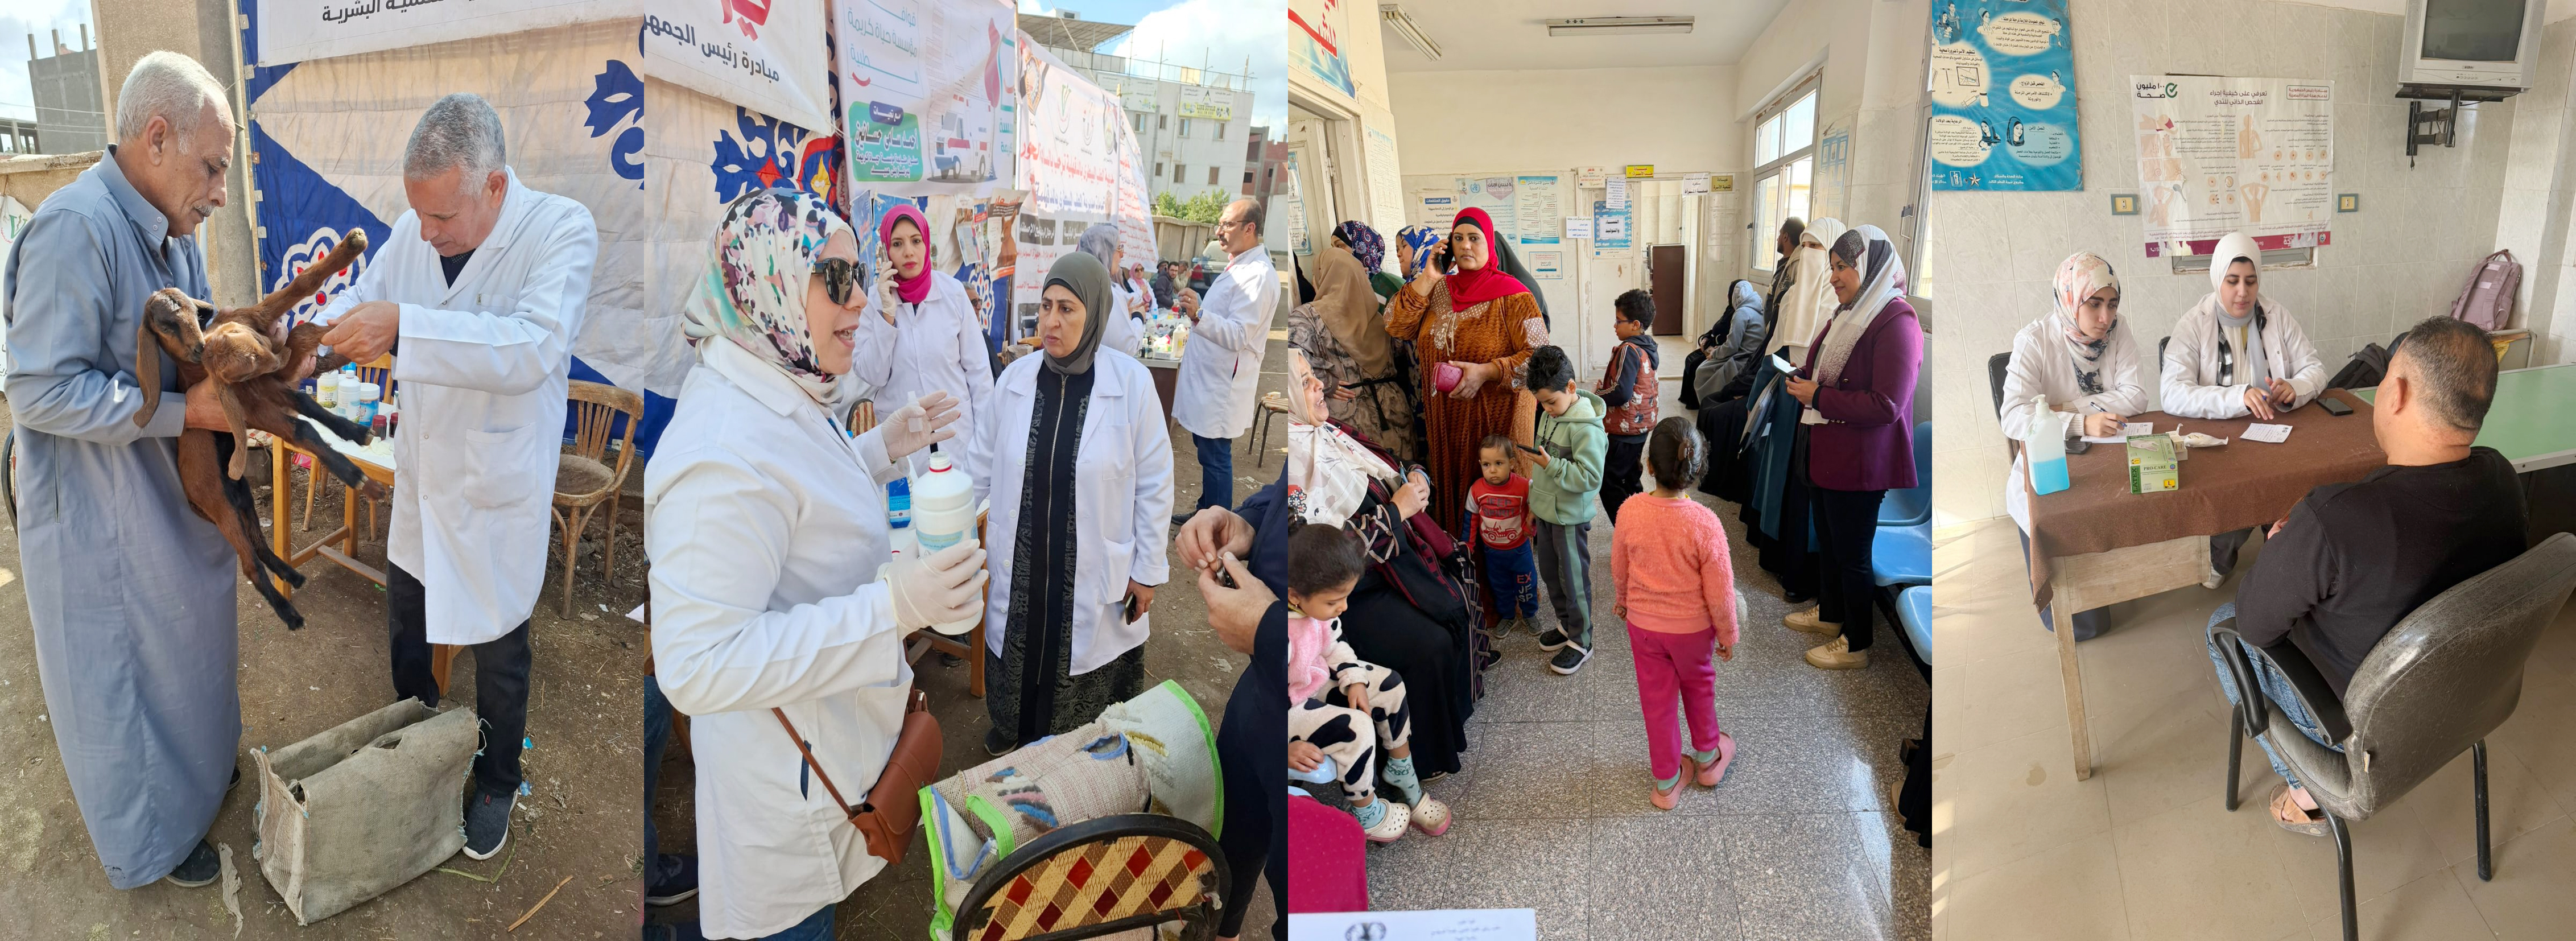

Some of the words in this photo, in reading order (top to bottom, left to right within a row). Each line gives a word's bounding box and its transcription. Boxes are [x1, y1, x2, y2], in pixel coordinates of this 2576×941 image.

[323, 0, 380, 24] البشرية
[848, 7, 874, 36] كريمة
[644, 12, 696, 46] الجمه
[875, 22, 891, 44] حياة
[701, 42, 737, 68] رئيس
[892, 29, 917, 57] مؤسسة
[741, 50, 779, 83] مبادرة
[2136, 82, 2156, 90] مليون
[2251, 90, 2267, 98] تعرفي
[2214, 98, 2228, 107] للثدي
[1000, 118, 1013, 134] سسة
